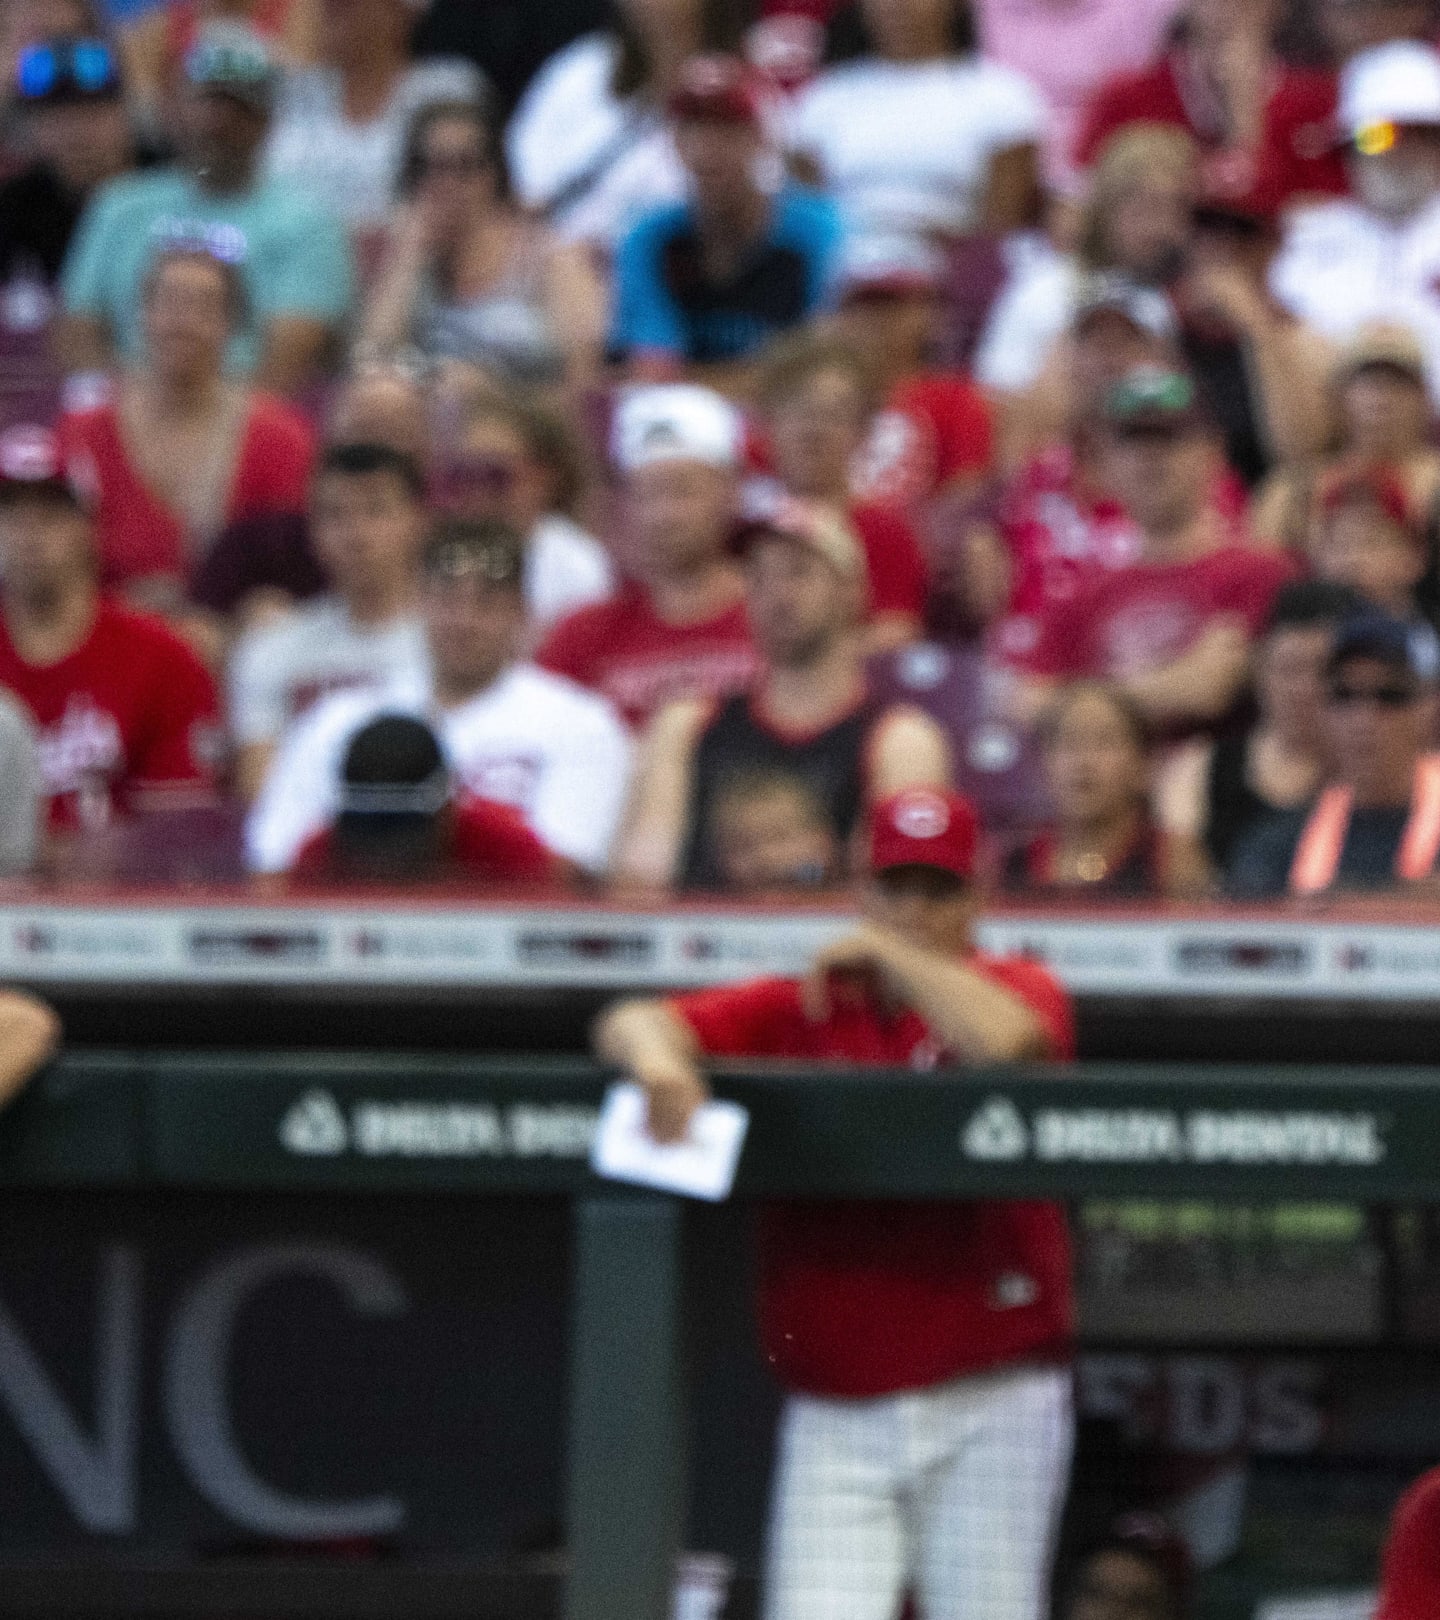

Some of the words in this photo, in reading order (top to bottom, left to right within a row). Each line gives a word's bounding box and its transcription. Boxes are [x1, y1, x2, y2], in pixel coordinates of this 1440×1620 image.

[353, 1101, 500, 1155] DELTA
[1034, 1108, 1184, 1163] DELTA
[1186, 1109, 1387, 1165] DENTAL
